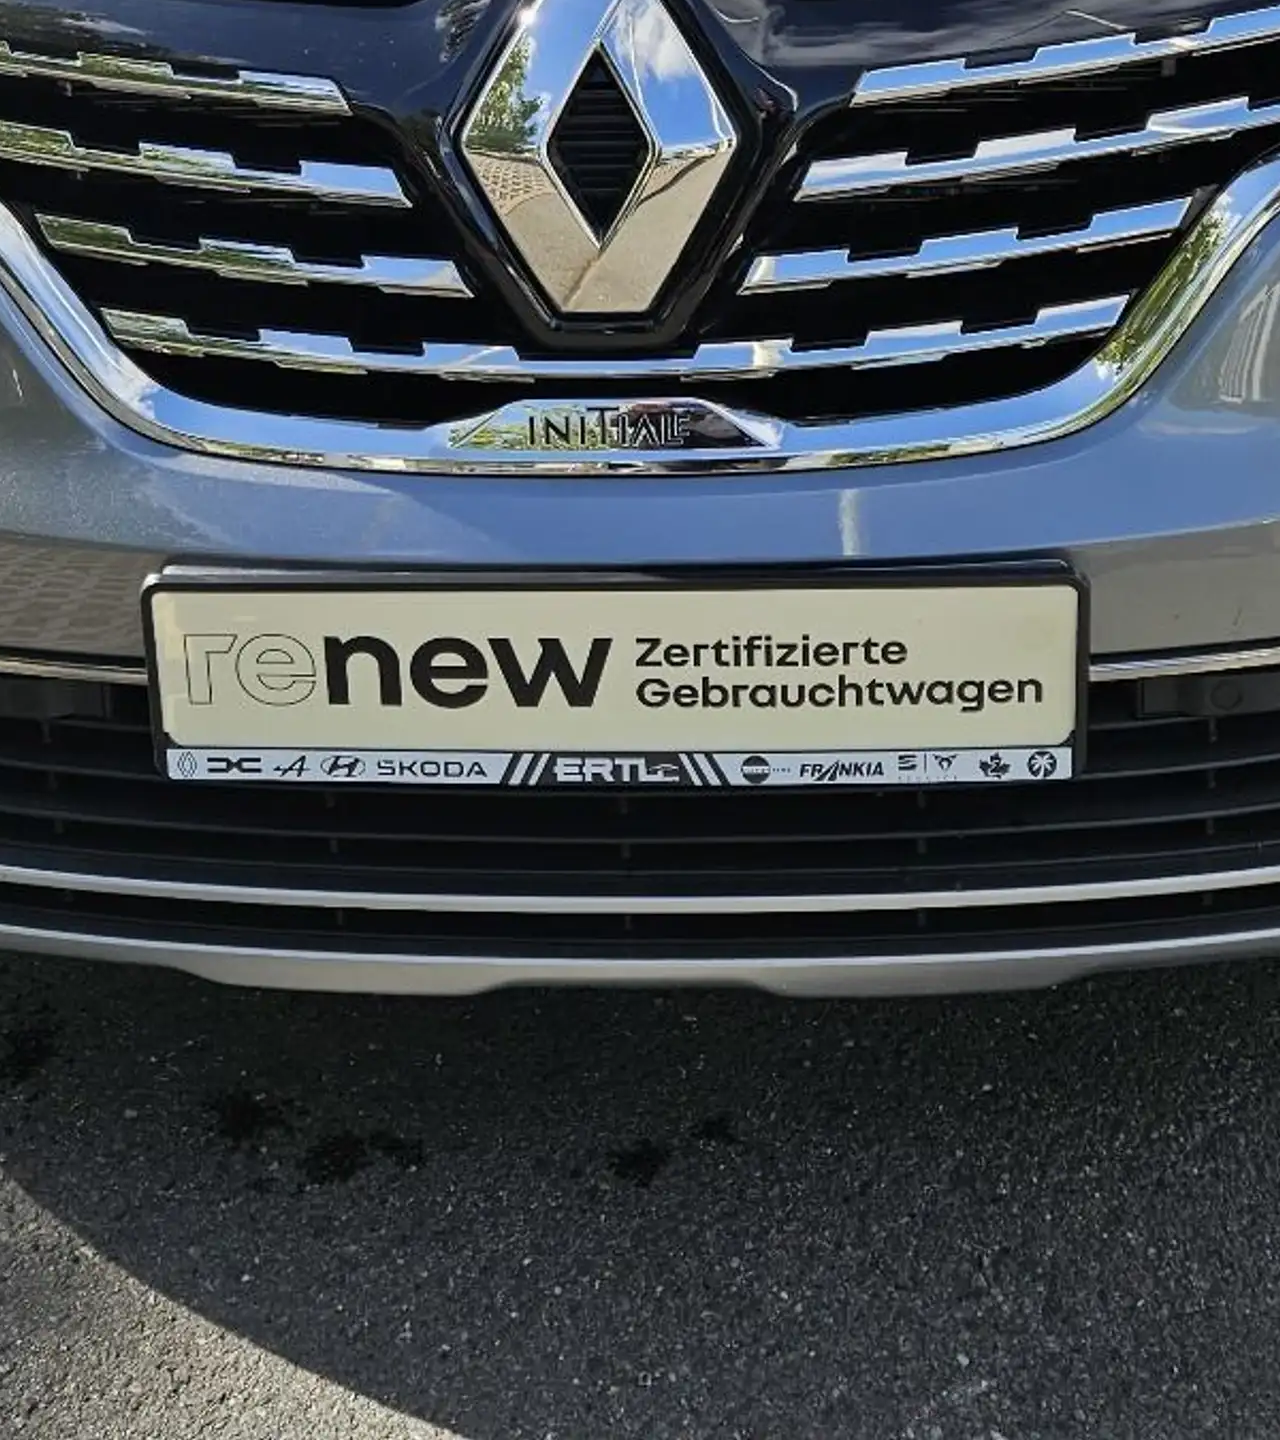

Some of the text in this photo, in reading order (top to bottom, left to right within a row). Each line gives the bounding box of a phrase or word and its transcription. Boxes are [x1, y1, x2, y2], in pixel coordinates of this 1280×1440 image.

[635, 634, 908, 668] Zertifizierte
[184, 633, 614, 708] renew
[636, 674, 1043, 713] Gebrauchtwagen
[553, 757, 680, 782] ERTL
[799, 760, 885, 782] FRANKIA
